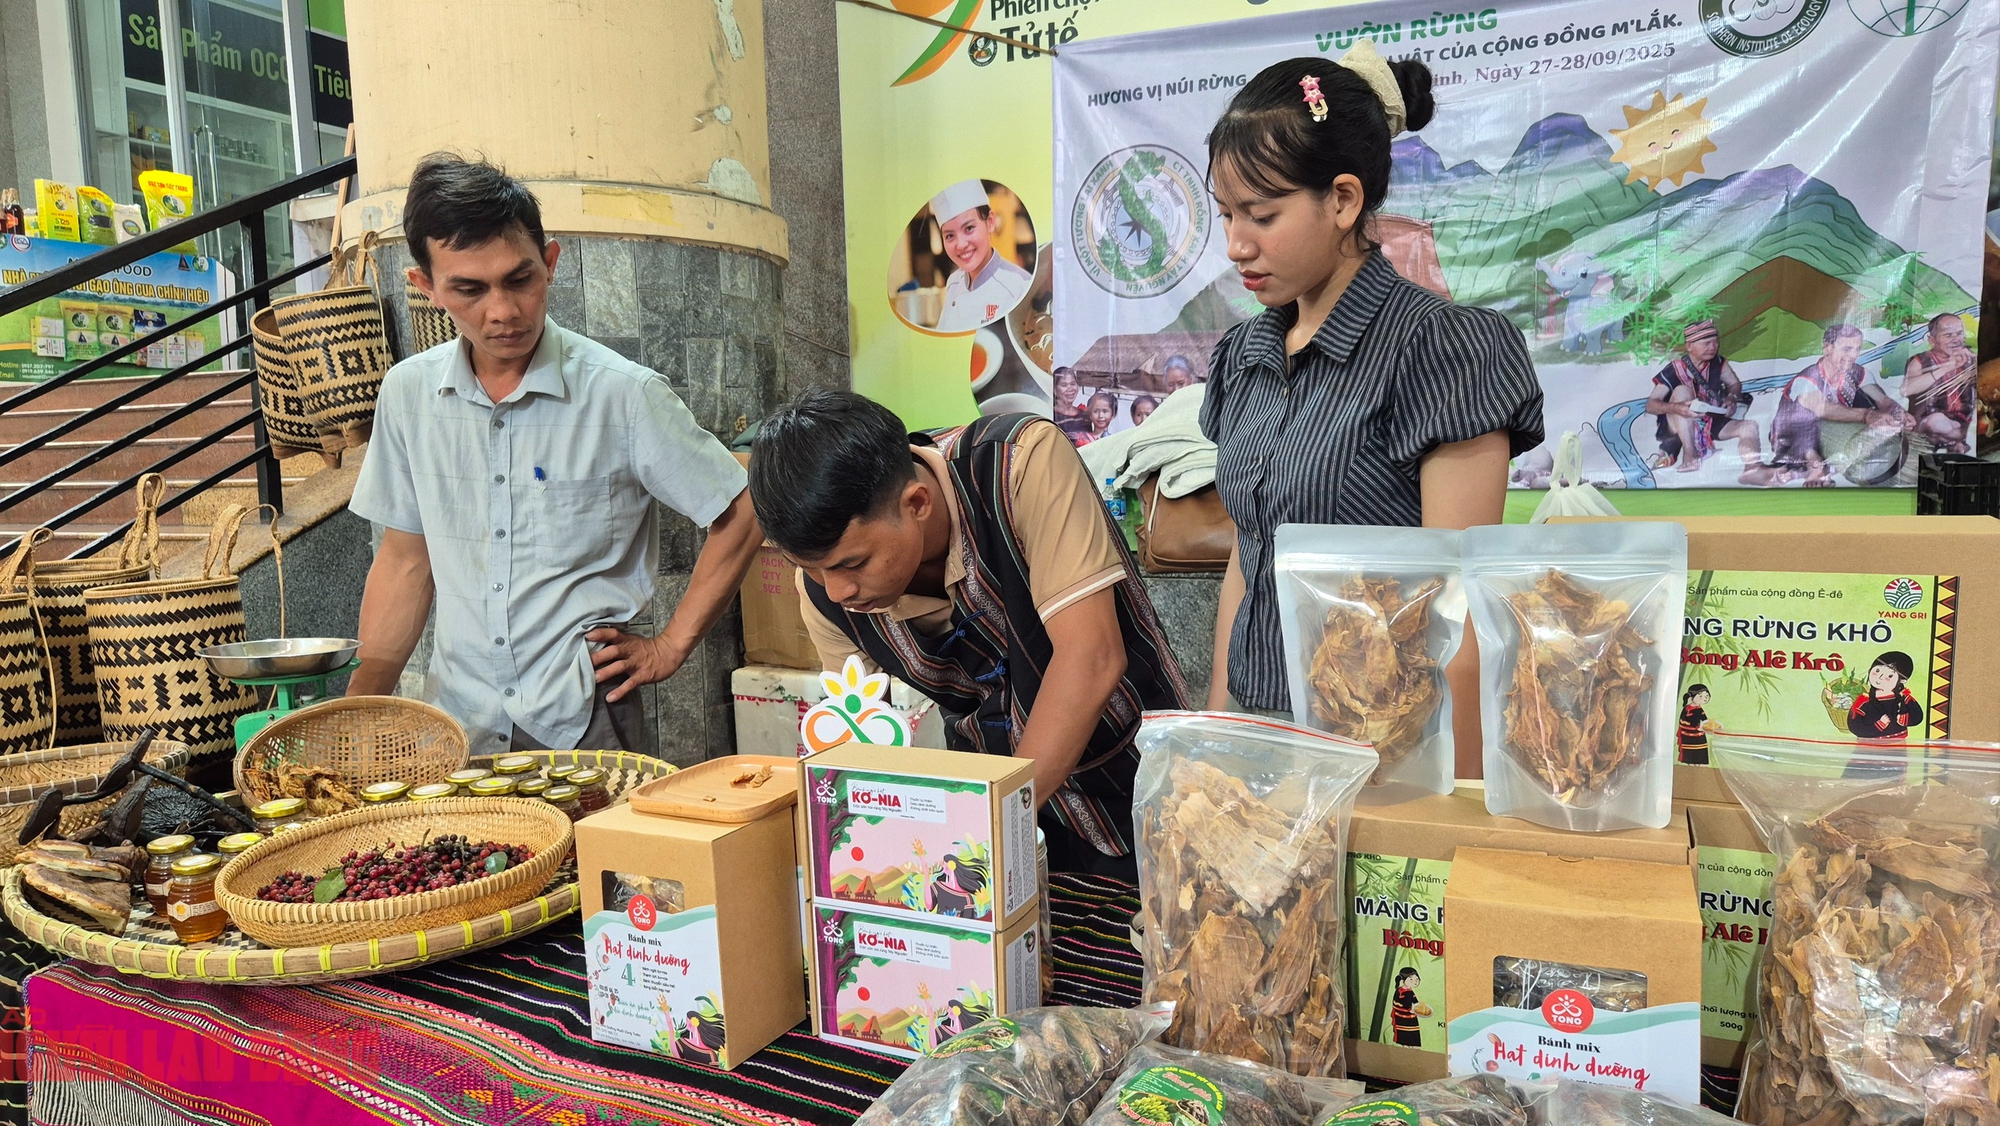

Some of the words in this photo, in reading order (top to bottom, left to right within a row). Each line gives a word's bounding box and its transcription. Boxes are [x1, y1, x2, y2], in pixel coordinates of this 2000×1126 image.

[1315, 21, 1402, 52] VƯỜN
[1410, 8, 1498, 41] RỪNG
[1439, 41, 1478, 59] CỦA
[1482, 35, 1539, 57] CỘNG
[1544, 23, 1606, 46] ĐỒNG
[1735, 37, 1779, 53] INSTITUTE
[1781, 30, 1794, 43] OF
[128, 13, 163, 50] Sả
[182, 28, 243, 72] Phẩm
[1434, 71, 1468, 87] inh,
[1475, 63, 1523, 83] Ngày
[1529, 42, 1676, 75] 27-28/09/2025
[1087, 86, 1143, 108] HƯƠNG
[1146, 86, 1162, 102] VỊ
[1166, 77, 1194, 97] NÚI
[1199, 74, 1248, 92] RỪNG
[1092, 160, 1114, 186] XANH
[1183, 170, 1201, 199] TNHH
[1074, 203, 1086, 243] TƯƠNG
[1079, 243, 1094, 266] MỘT
[2, 267, 28, 285] NHÀ
[89, 278, 110, 297] GẠO
[113, 278, 133, 296] ÔNG
[135, 284, 155, 297] CUA
[157, 284, 186, 300] CHÍNH
[187, 287, 210, 305] HIỆU
[1688, 585, 1708, 595] Sản
[1710, 585, 1738, 598] phẩm
[1740, 587, 1759, 597] của
[1761, 588, 1786, 599] cộng
[1788, 586, 1815, 600] đồng
[1818, 587, 1843, 599] Ê-đê
[1878, 610, 1907, 619] YANG
[1910, 611, 1927, 620] GRI
[1684, 618, 1723, 637] NG
[1732, 614, 1817, 640] RỪNG
[1827, 619, 1893, 643] KHÔ
[1744, 650, 1787, 669] Alê
[1792, 652, 1845, 672] Krô
[816, 796, 837, 804] TONO
[852, 791, 902, 807] KƠ-NIA
[1415, 873, 1440, 884] phẩm
[1707, 863, 1725, 872] của
[1727, 866, 1751, 877] cộng
[1754, 867, 1774, 878] đồn
[1356, 895, 1428, 921] MĂNG
[634, 916, 651, 925] TONO
[628, 933, 646, 944] Bánh
[648, 938, 662, 947] mix
[824, 935, 844, 944] TONO
[858, 933, 907, 951] KƠ-NIA
[1382, 928, 1445, 956] Bông
[1712, 922, 1754, 944] Alê
[604, 939, 623, 959] Hạt
[626, 944, 652, 962] dinh
[654, 950, 690, 976] dưỡng
[621, 963, 636, 987] 4
[1552, 1014, 1582, 1026] TONO
[1720, 1007, 1746, 1019] lượng
[1720, 1021, 1743, 1031] 500g
[1538, 1035, 1571, 1050] Bánh
[1576, 1040, 1601, 1053] mix
[1493, 1041, 1527, 1066] Hạt
[1533, 1049, 1581, 1071] dinh
[1586, 1057, 1650, 1091] dưỡng
